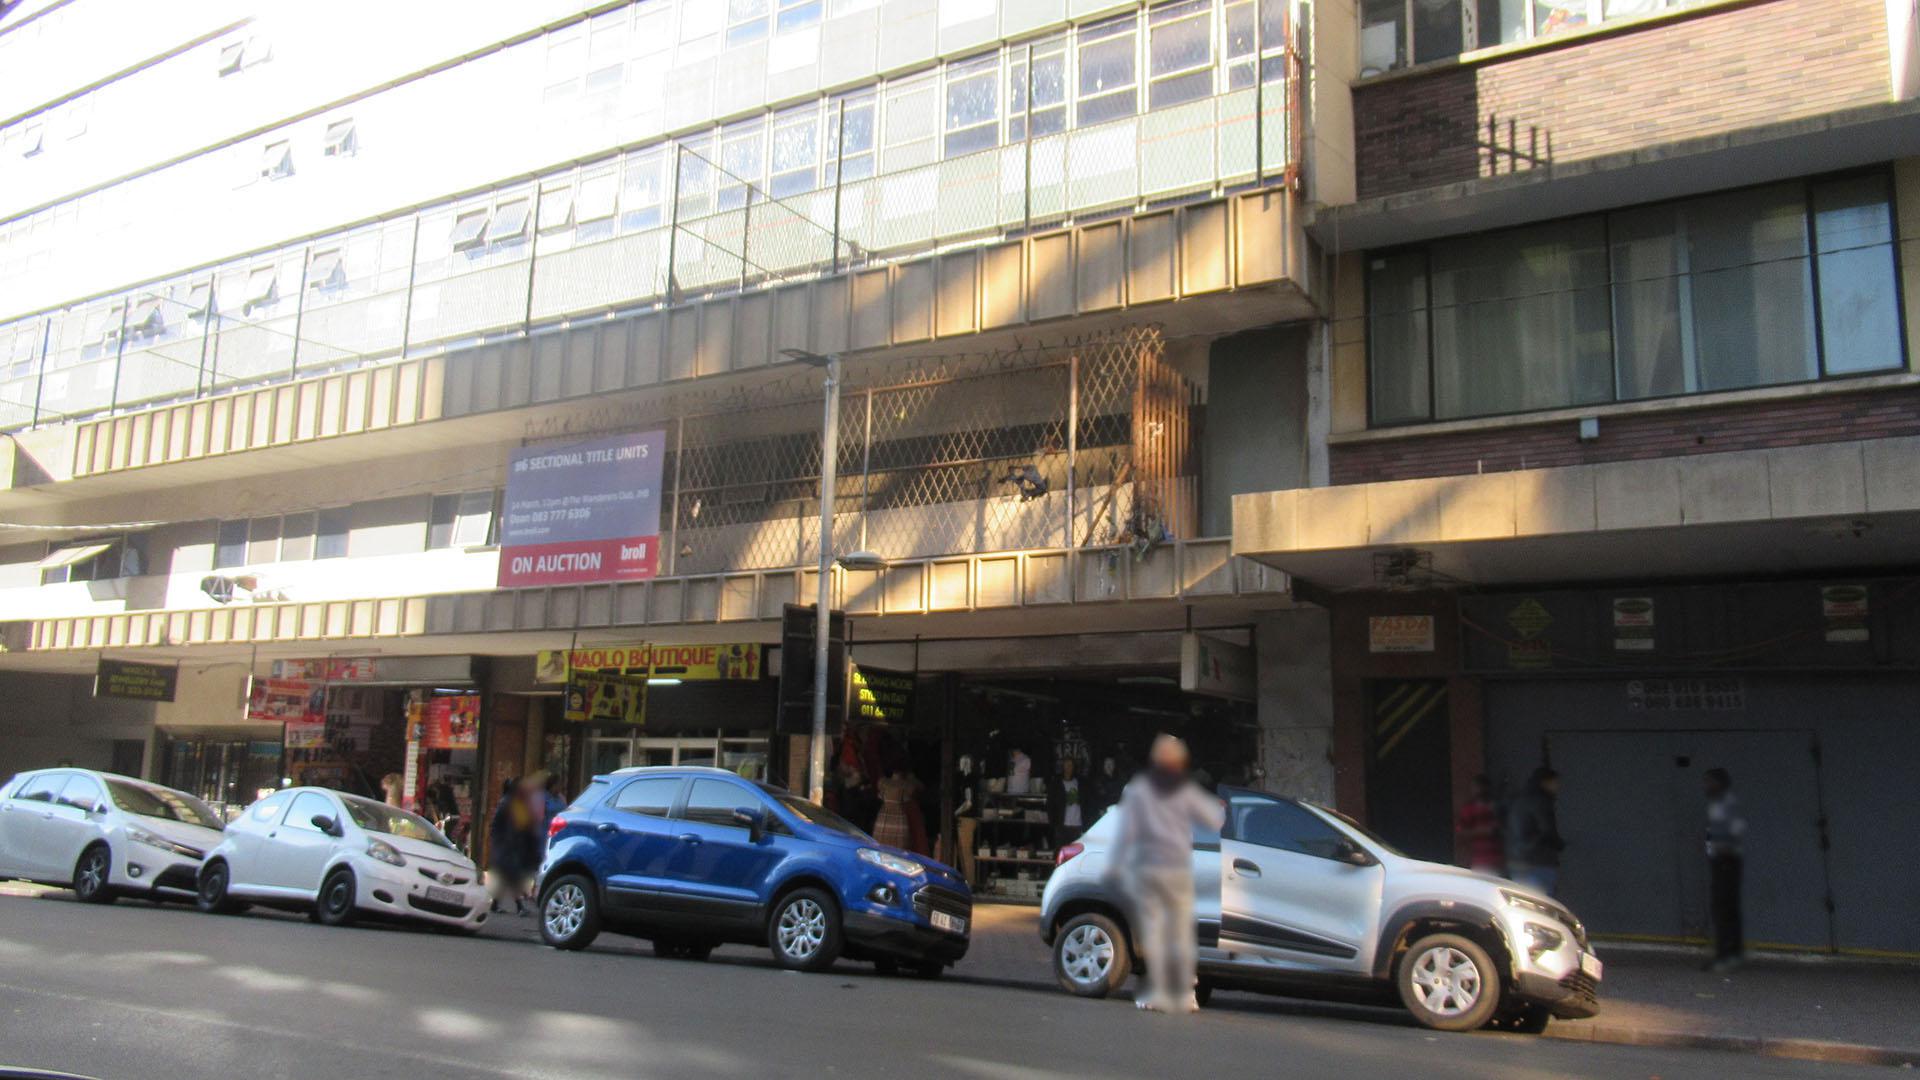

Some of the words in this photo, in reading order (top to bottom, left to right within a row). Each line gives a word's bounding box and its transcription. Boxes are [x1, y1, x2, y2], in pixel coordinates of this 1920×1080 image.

[528, 453, 584, 470] SECTIONAL
[586, 448, 614, 463] TITLE
[615, 444, 649, 460] UNITS
[549, 509, 567, 521] 777
[621, 543, 647, 561] broll
[512, 556, 533, 575] ON
[536, 552, 602, 573] AUCTION
[628, 647, 716, 666] BOUTIQUE
[861, 703, 874, 717] 011
